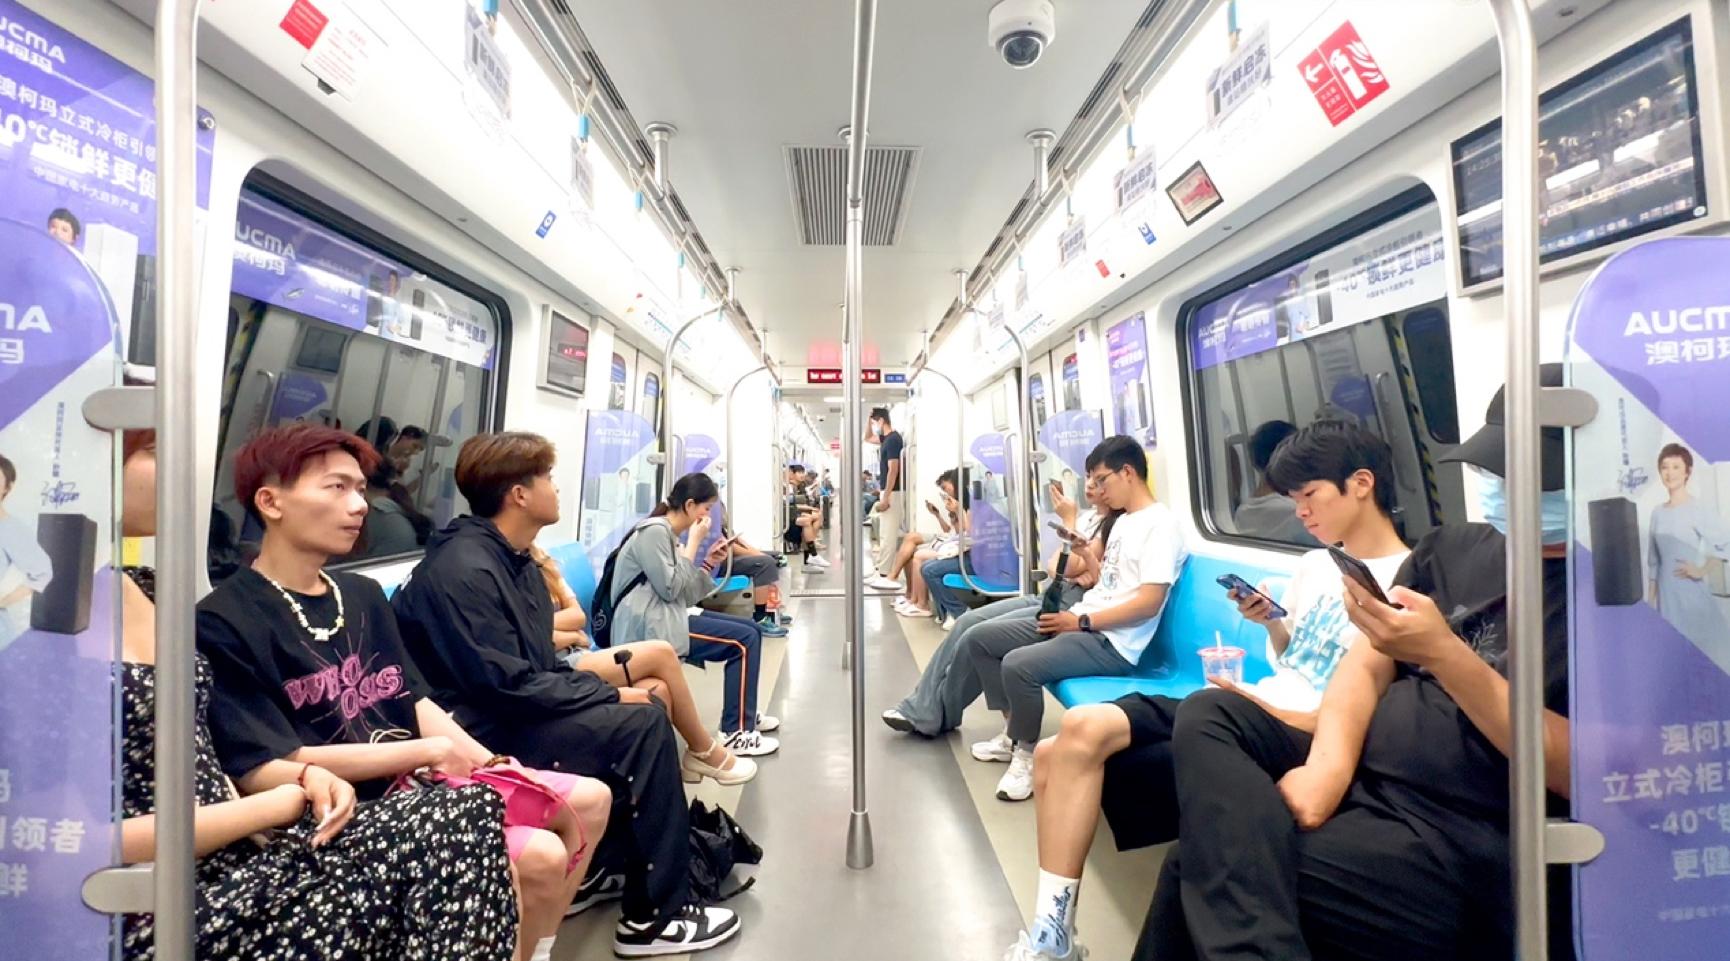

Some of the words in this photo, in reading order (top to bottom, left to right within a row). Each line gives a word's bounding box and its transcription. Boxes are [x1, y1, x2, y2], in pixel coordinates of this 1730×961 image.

[0, 34, 53, 74] 柯玛
[1660, 720, 1730, 756] 澳柯
[1602, 761, 1730, 804] 立式冷柜
